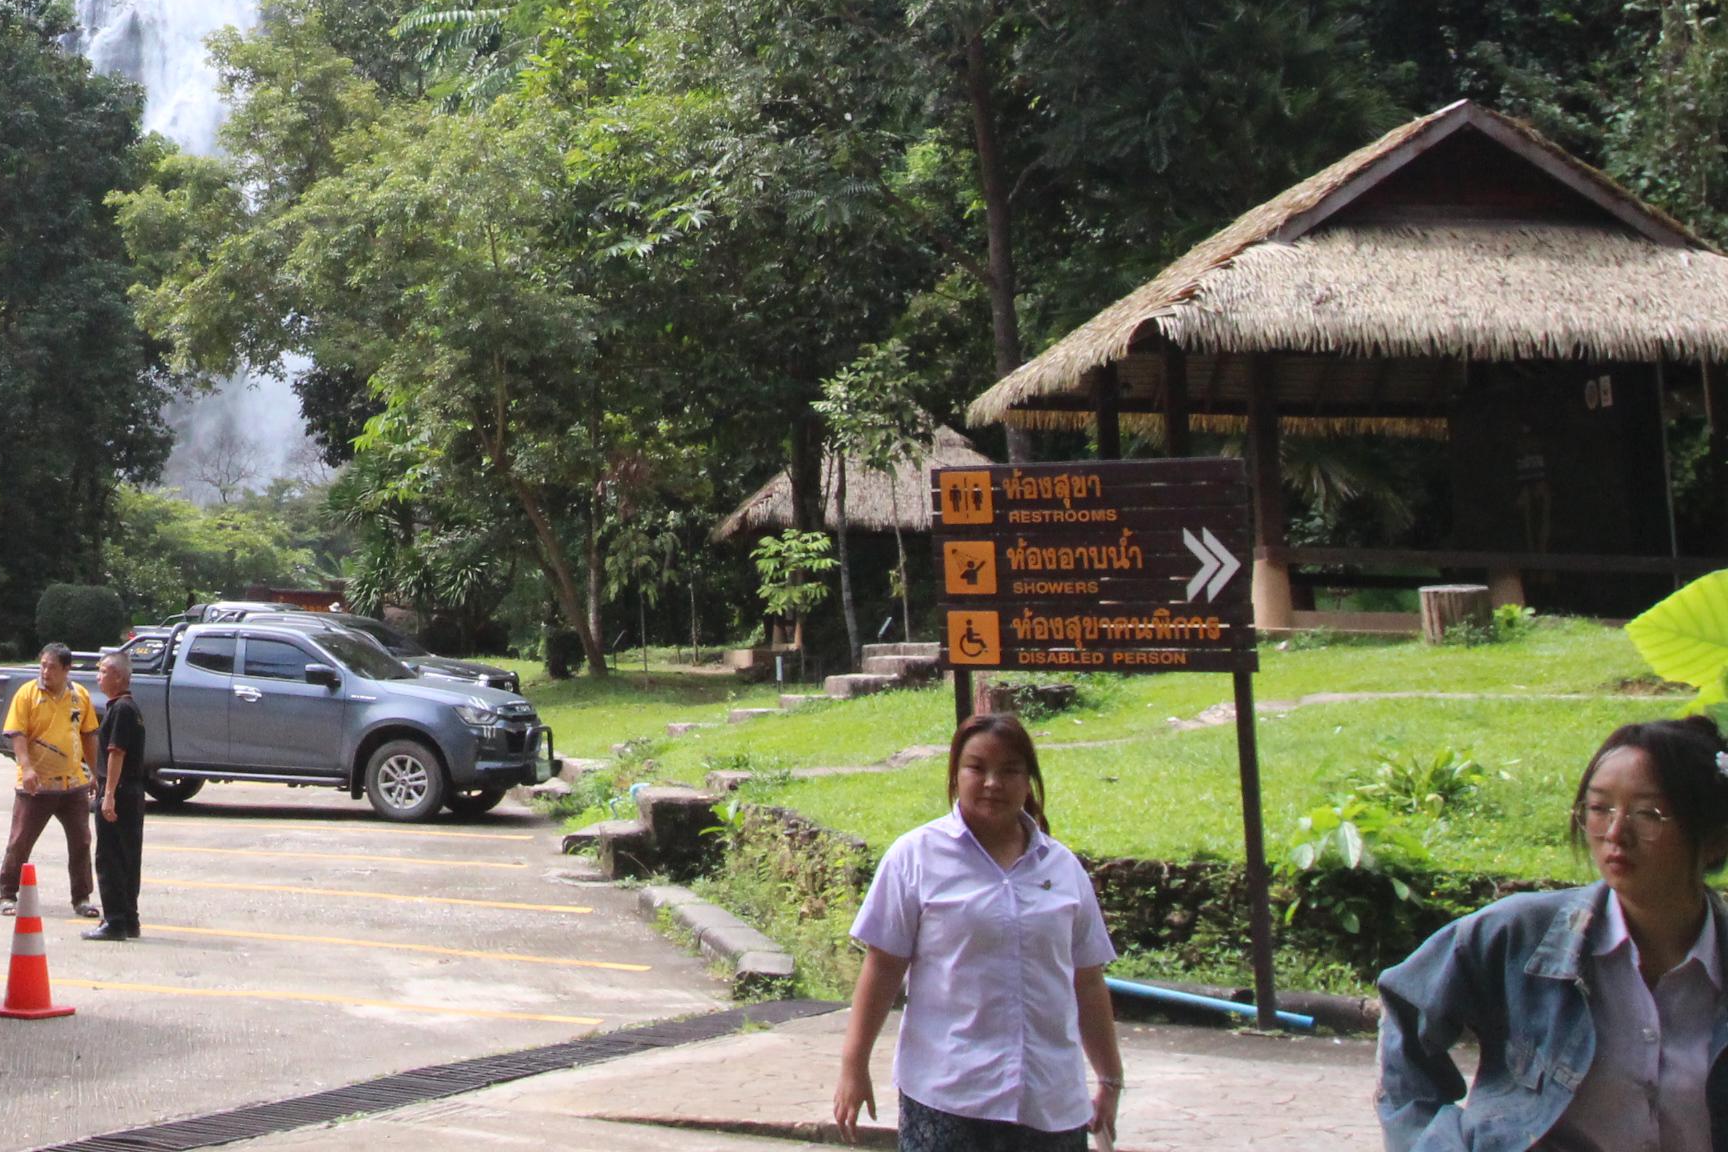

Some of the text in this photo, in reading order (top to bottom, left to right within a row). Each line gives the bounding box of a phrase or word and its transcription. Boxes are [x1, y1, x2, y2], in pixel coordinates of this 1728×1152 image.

[1002, 468, 1101, 509] ห้องสุขา
[1009, 509, 1117, 523] RESTROOMS
[1007, 528, 1142, 569] ห้องอาบน้ำ
[1013, 581, 1100, 594] SHOWERS
[1012, 608, 1221, 649] ห้องสุขาคนพิการ
[1018, 651, 1186, 665] DISABLED PERSON
